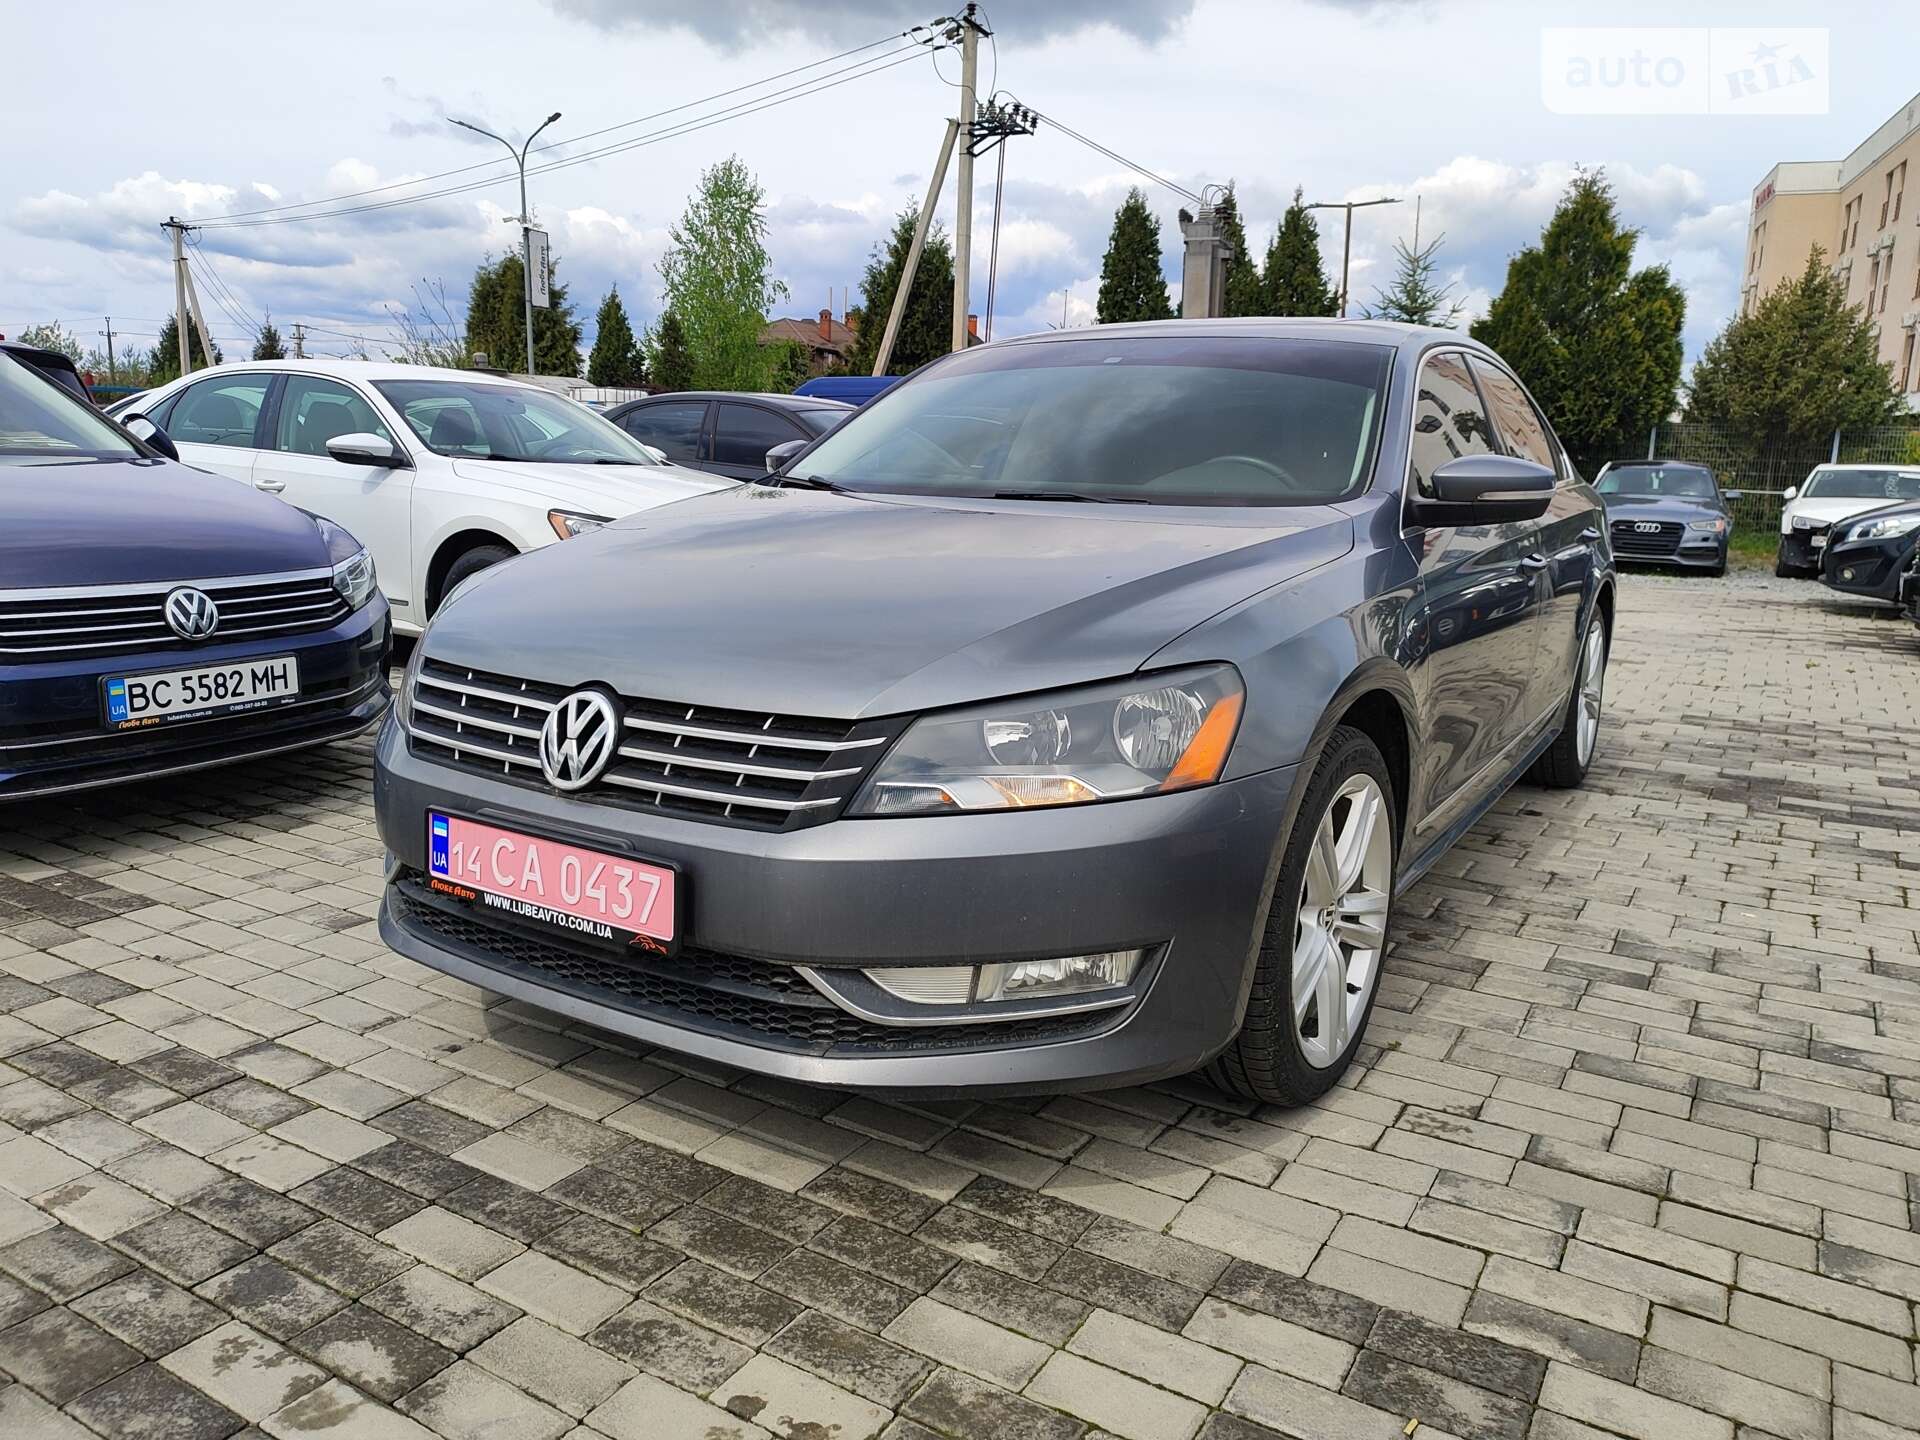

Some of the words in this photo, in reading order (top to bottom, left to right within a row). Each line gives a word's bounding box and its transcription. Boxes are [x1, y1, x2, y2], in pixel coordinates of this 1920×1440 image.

[112, 706, 126, 715] UA
[128, 680, 172, 712] BC
[181, 670, 245, 704] 5582
[250, 663, 289, 694] MH
[433, 851, 448, 868] UA
[452, 841, 481, 881] 14
[560, 855, 662, 925] 0437
[484, 892, 613, 940] WWW.LUBEAVTO.COM.UA
